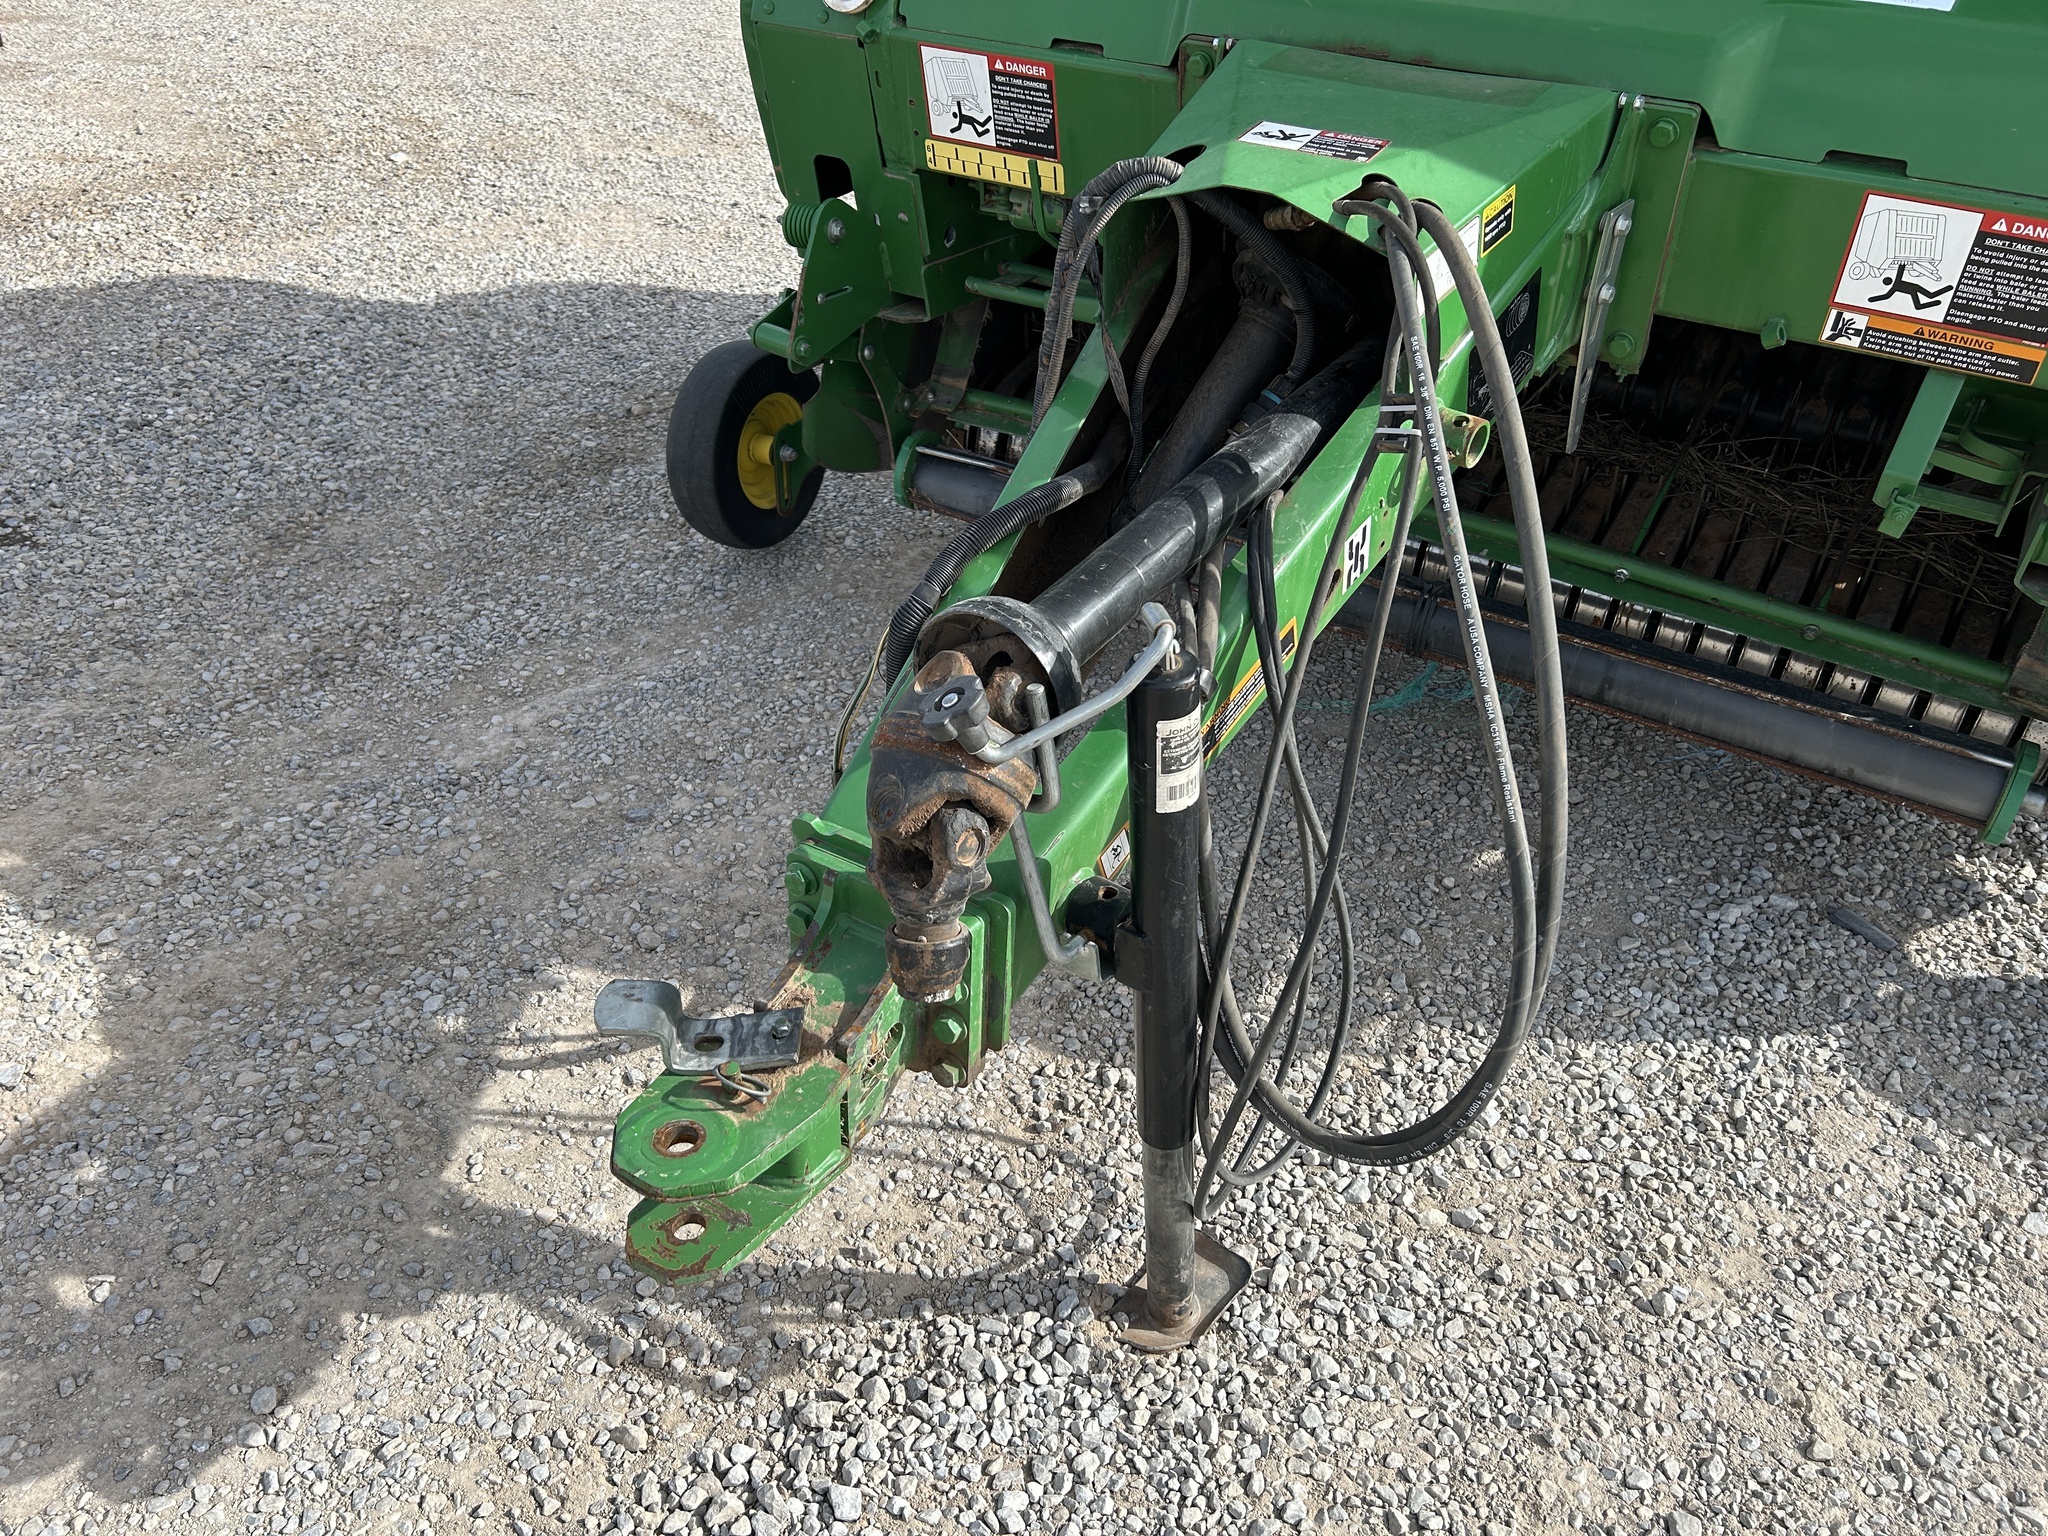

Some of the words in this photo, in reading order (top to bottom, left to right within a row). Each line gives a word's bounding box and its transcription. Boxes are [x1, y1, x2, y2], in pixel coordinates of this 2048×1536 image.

[1006, 61, 1046, 76] DANGER
[1336, 134, 1382, 144] DANGER
[1489, 193, 1513, 217] CAUTION
[2011, 222, 2048, 238] DAN
[1985, 237, 2010, 246] DON'T
[2012, 242, 2033, 251] TAKE
[1970, 254, 1990, 263] being
[2005, 253, 2028, 263] injury
[1978, 267, 1994, 275] NOT
[1996, 271, 2023, 280] attempt
[1956, 291, 1985, 300] material
[1996, 284, 2020, 294] WHILE
[2021, 289, 2047, 299] BALER
[1968, 301, 1995, 309] release
[1946, 316, 1971, 324] engine.
[1949, 308, 1986, 320] Disengage
[1411, 336, 1420, 352] SAE
[1867, 330, 1886, 338] Avoid
[1887, 334, 1917, 345] crushing
[1918, 340, 1946, 350] between
[1928, 328, 1994, 350] WARNING
[1866, 335, 1886, 344] Twine
[1940, 352, 1990, 366] unexpectedly.
[1881, 346, 1902, 354] hands
[1414, 351, 1423, 369] 100R
[1418, 372, 1426, 382] 16
[1424, 406, 1433, 420] DIN
[1426, 422, 1436, 435] EN
[1433, 454, 1443, 474] W.P.
[1442, 498, 1451, 512] PSI
[1453, 554, 1466, 585] GATOR
[1460, 586, 1472, 610] HOSE
[1466, 618, 1474, 626] A
[1469, 626, 1478, 645] USA
[1473, 645, 1489, 688] COMPANY
[1483, 694, 1496, 720] MSHA
[1166, 724, 1192, 736] JOHN
[1496, 757, 1508, 783] Flame
[1503, 784, 1517, 824] Resistant
[1478, 1082, 1493, 1099] SAE
[1262, 1096, 1277, 1114] HOSE
[1465, 1100, 1482, 1118] 100R
[1277, 1116, 1301, 1136] GATOR
[1410, 1150, 1423, 1159] EN
[1424, 1142, 1439, 1152] DIN
